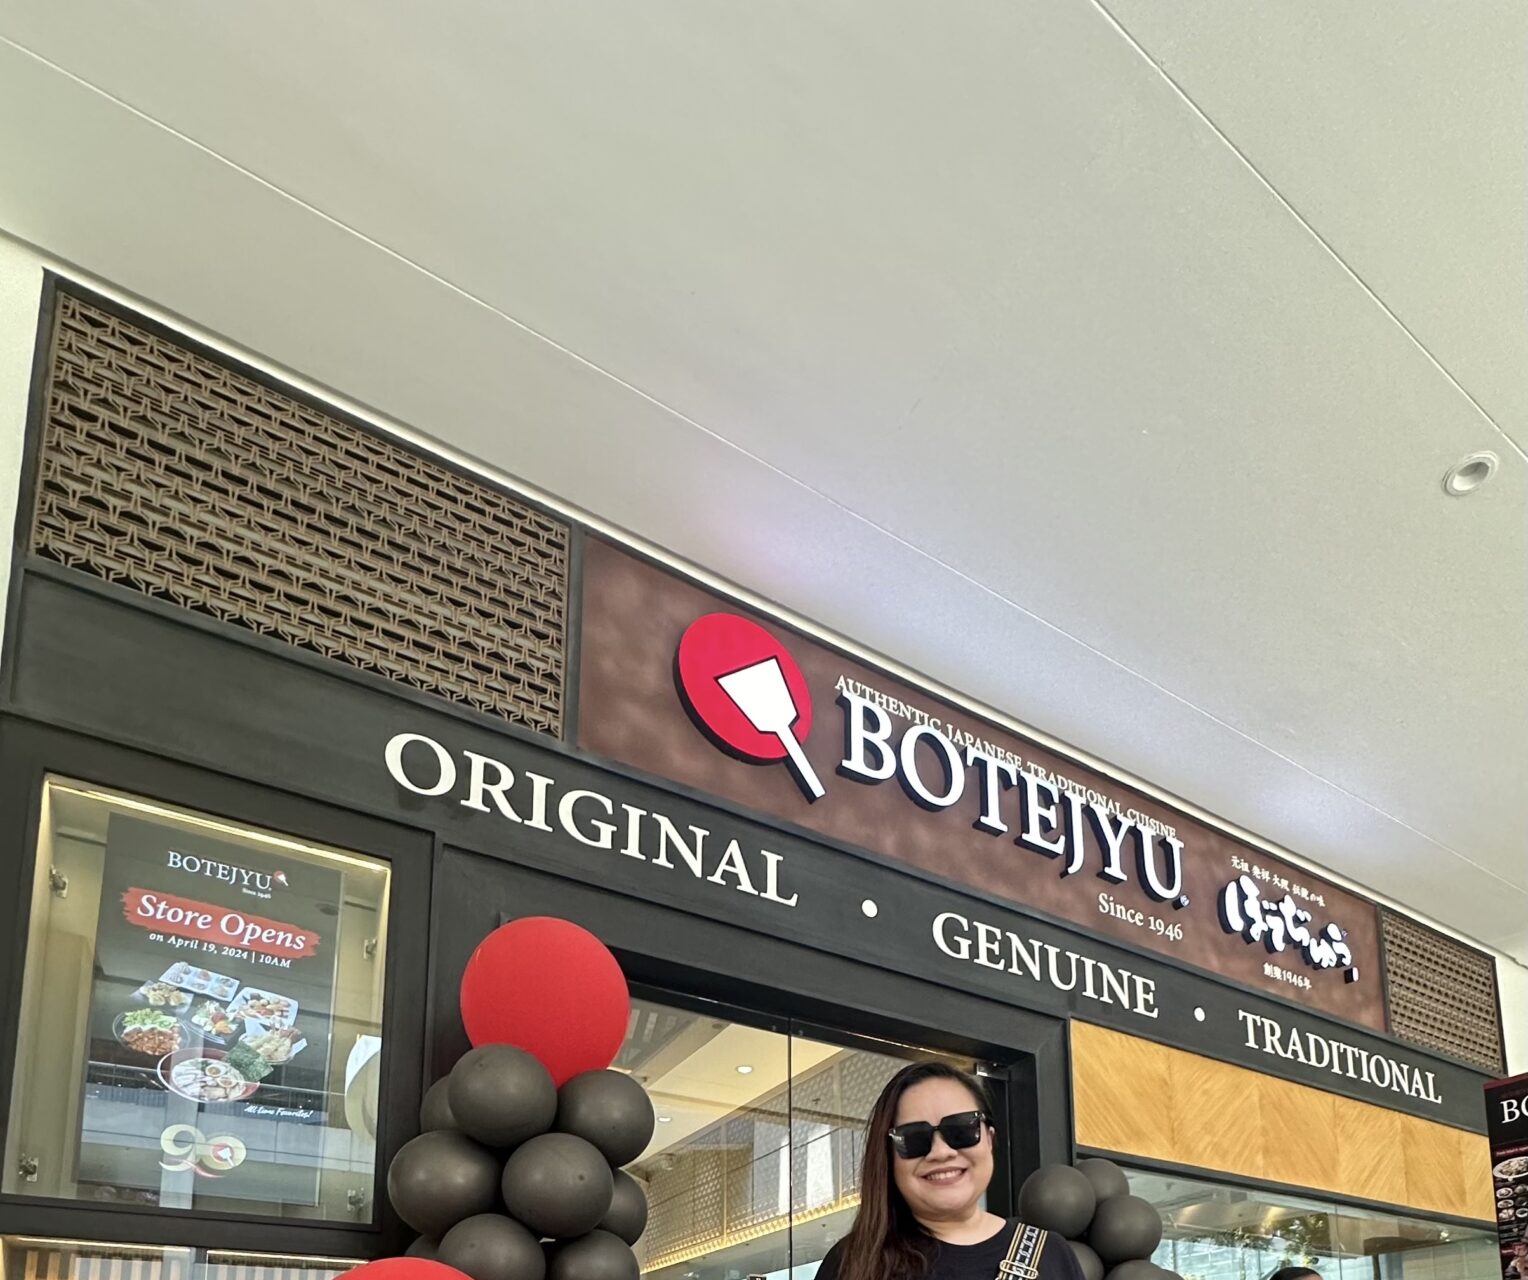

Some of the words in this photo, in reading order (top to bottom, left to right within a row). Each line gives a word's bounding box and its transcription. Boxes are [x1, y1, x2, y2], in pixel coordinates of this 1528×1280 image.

[835, 675, 942, 732] AUTHENTIC
[945, 724, 1024, 772] JAPANESE
[1027, 761, 1125, 817] TRADITIONAL
[1126, 808, 1178, 840] CUISINE
[841, 688, 1186, 901] BOTEJYU
[384, 732, 799, 908] ORIGINAL
[167, 850, 272, 891] BOTEJYU
[1098, 892, 1144, 927] Since
[1148, 915, 1184, 942] 1946
[136, 894, 213, 930] Store
[220, 913, 307, 951] Opens
[149, 932, 164, 943] on
[167, 934, 199, 951] April
[202, 941, 218, 955] 19,
[221, 946, 249, 960] 2024
[259, 954, 293, 969] 10AM
[932, 912, 1160, 1019] GENUINE
[1238, 1009, 1443, 1105] TRADITIONAL
